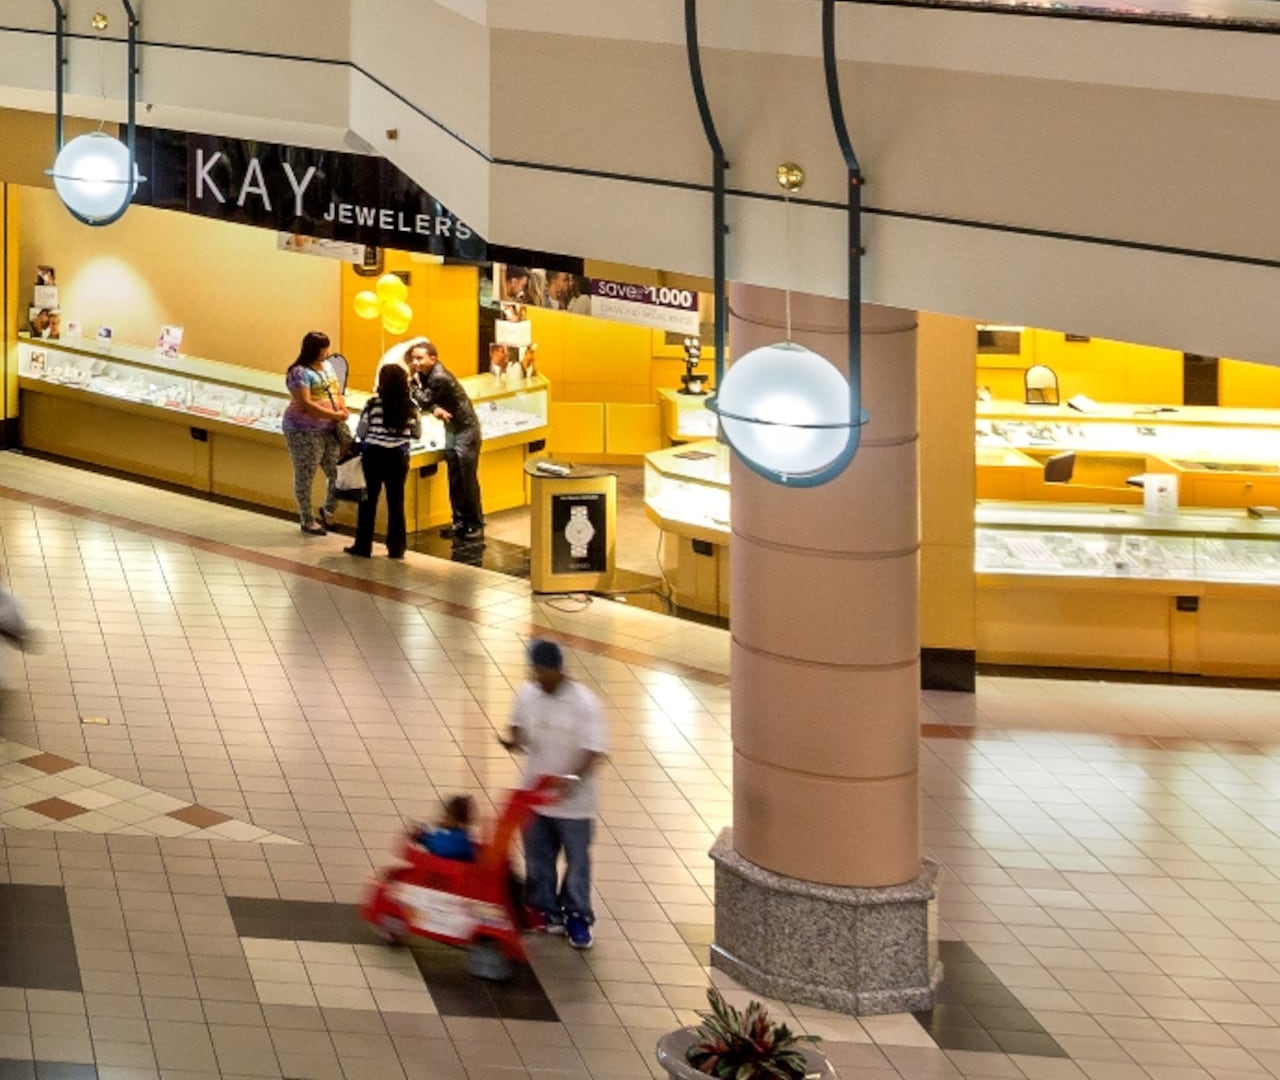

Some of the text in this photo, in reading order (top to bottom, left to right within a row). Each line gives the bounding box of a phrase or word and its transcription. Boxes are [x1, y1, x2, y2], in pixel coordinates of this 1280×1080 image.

[195, 148, 473, 240] KAY JEWELERS
[598, 281, 637, 298] save
